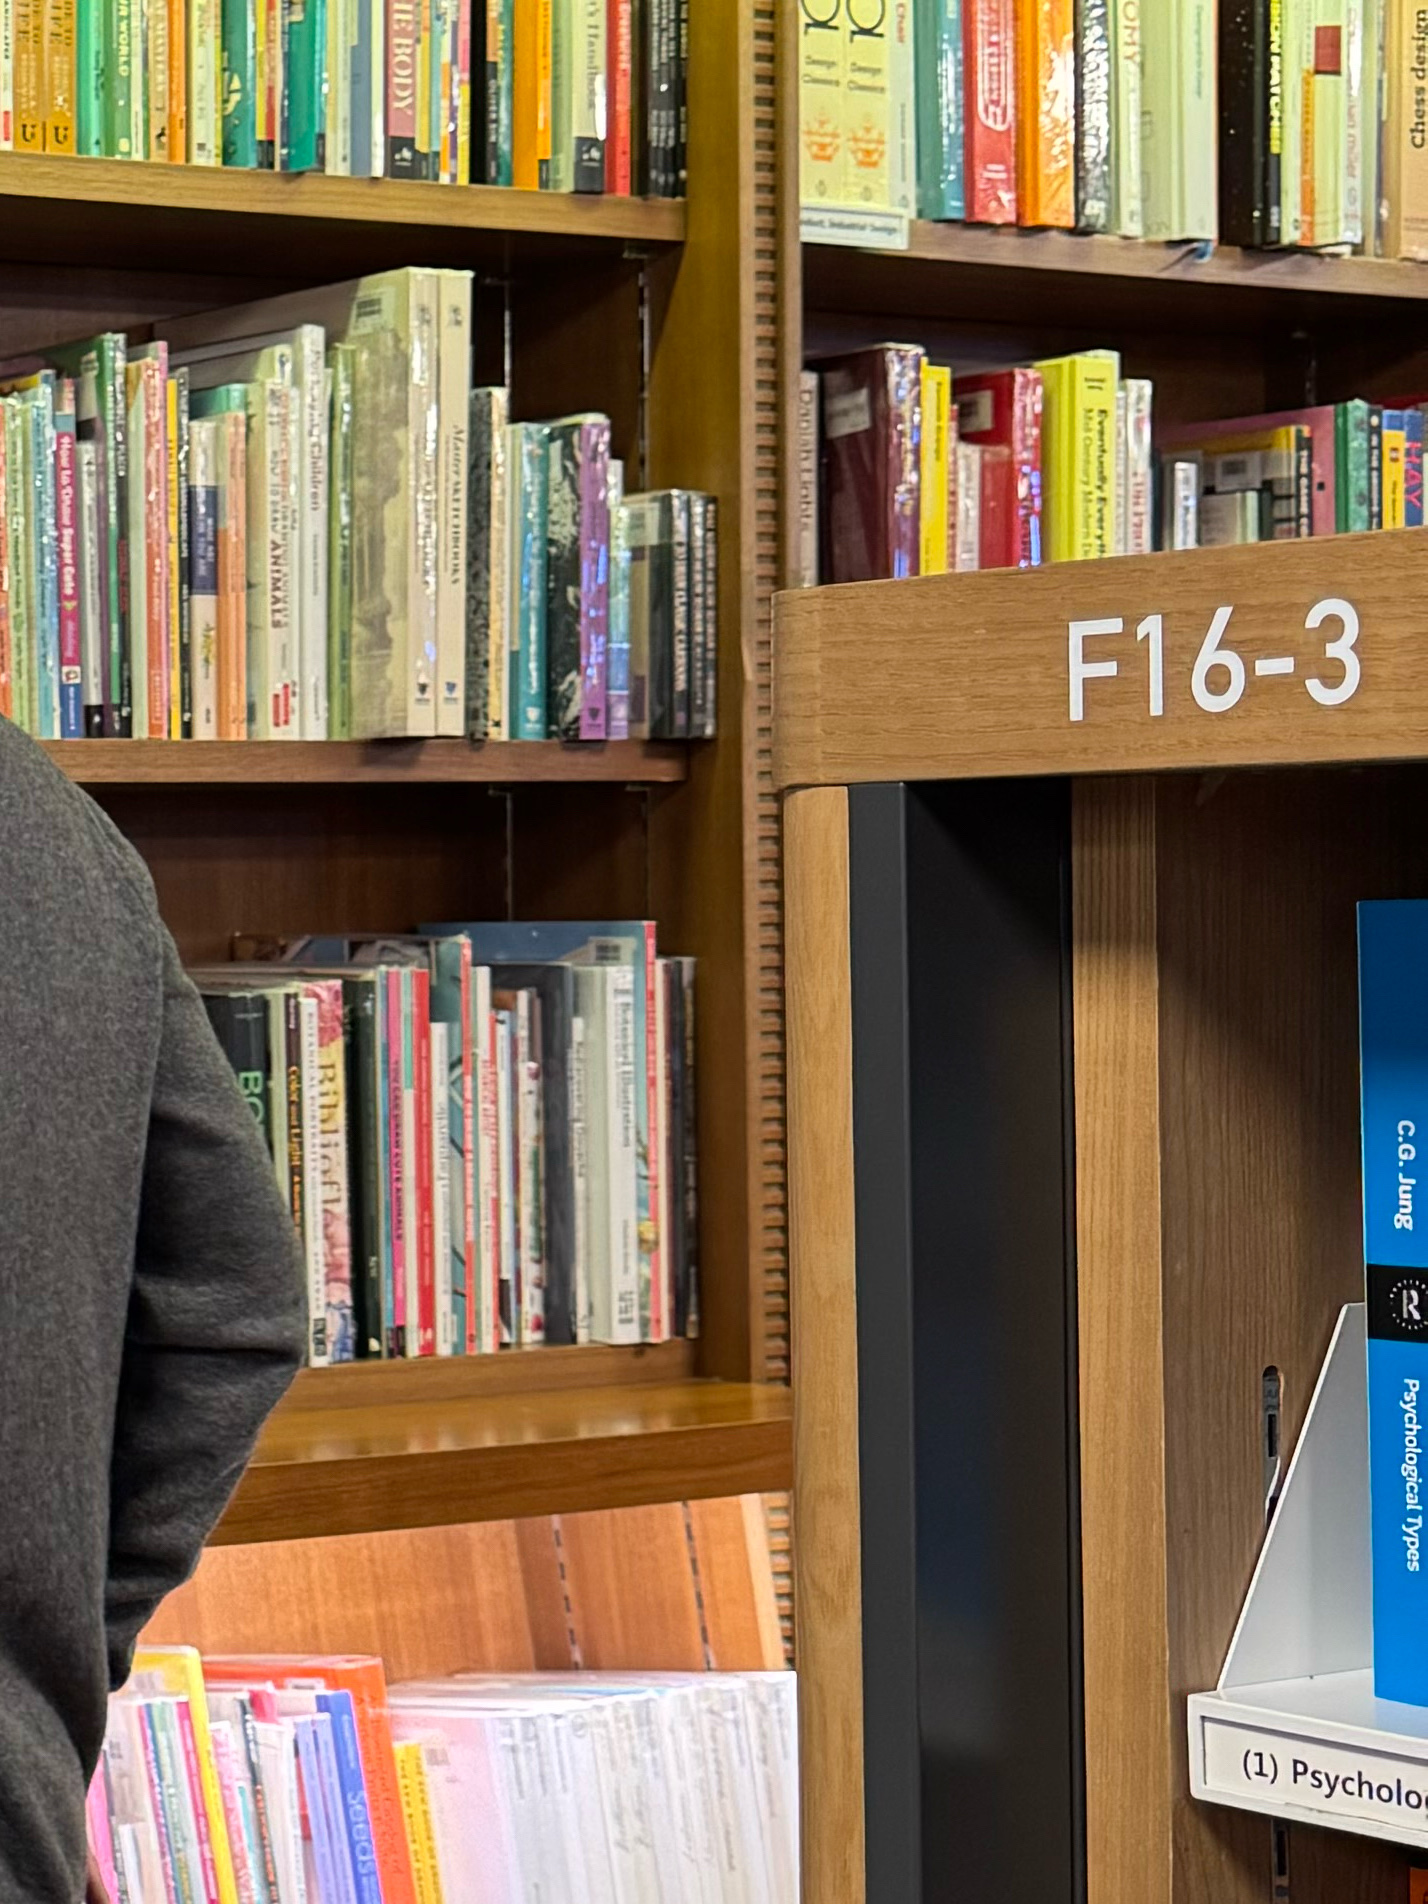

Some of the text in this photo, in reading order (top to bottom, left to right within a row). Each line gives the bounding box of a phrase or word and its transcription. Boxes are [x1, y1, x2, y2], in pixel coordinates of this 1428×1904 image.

[391, 32, 415, 115] BODY
[1410, 86, 1426, 150] Chess
[1068, 598, 1361, 721] F16-3
[1393, 1118, 1415, 1231] C.G. Jung
[1401, 1378, 1420, 1572] Psychological Types
[1243, 1749, 1428, 1810] (1) Psycholo
